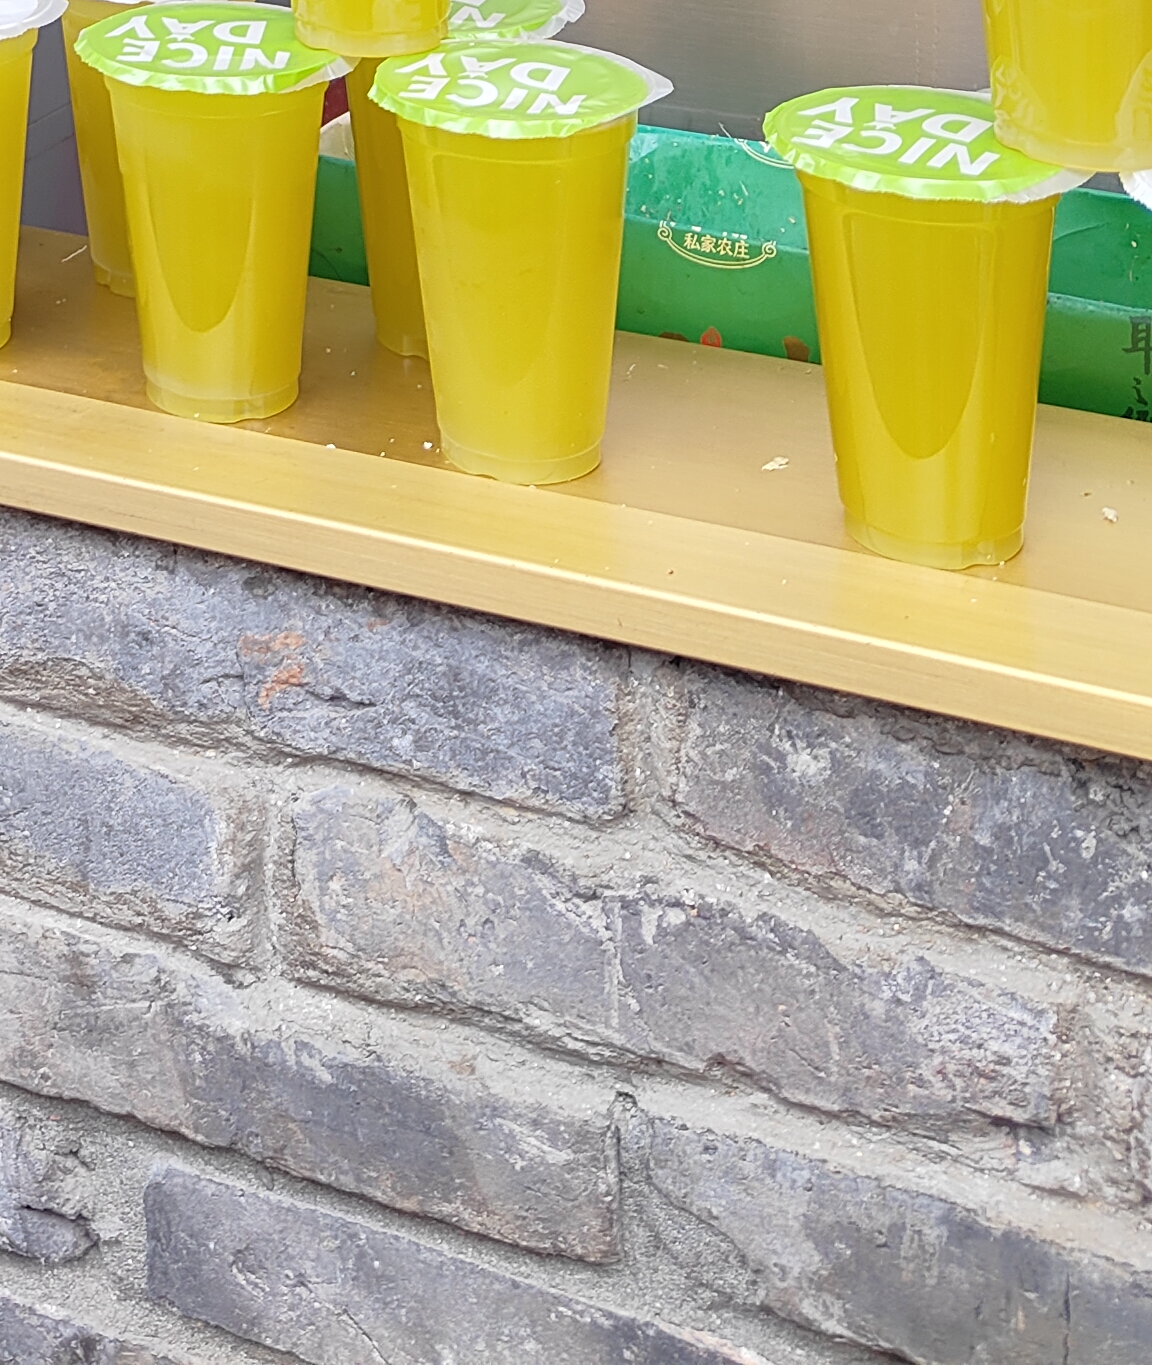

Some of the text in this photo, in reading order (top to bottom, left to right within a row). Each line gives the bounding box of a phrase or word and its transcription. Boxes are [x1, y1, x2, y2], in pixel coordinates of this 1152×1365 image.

[104, 15, 267, 45] DAY
[116, 37, 291, 71] NICE
[395, 52, 571, 91] DAY
[398, 75, 587, 115] NICE
[797, 97, 994, 143] DAY
[791, 119, 1000, 176] NICE
[683, 232, 750, 259] 私家农庄
